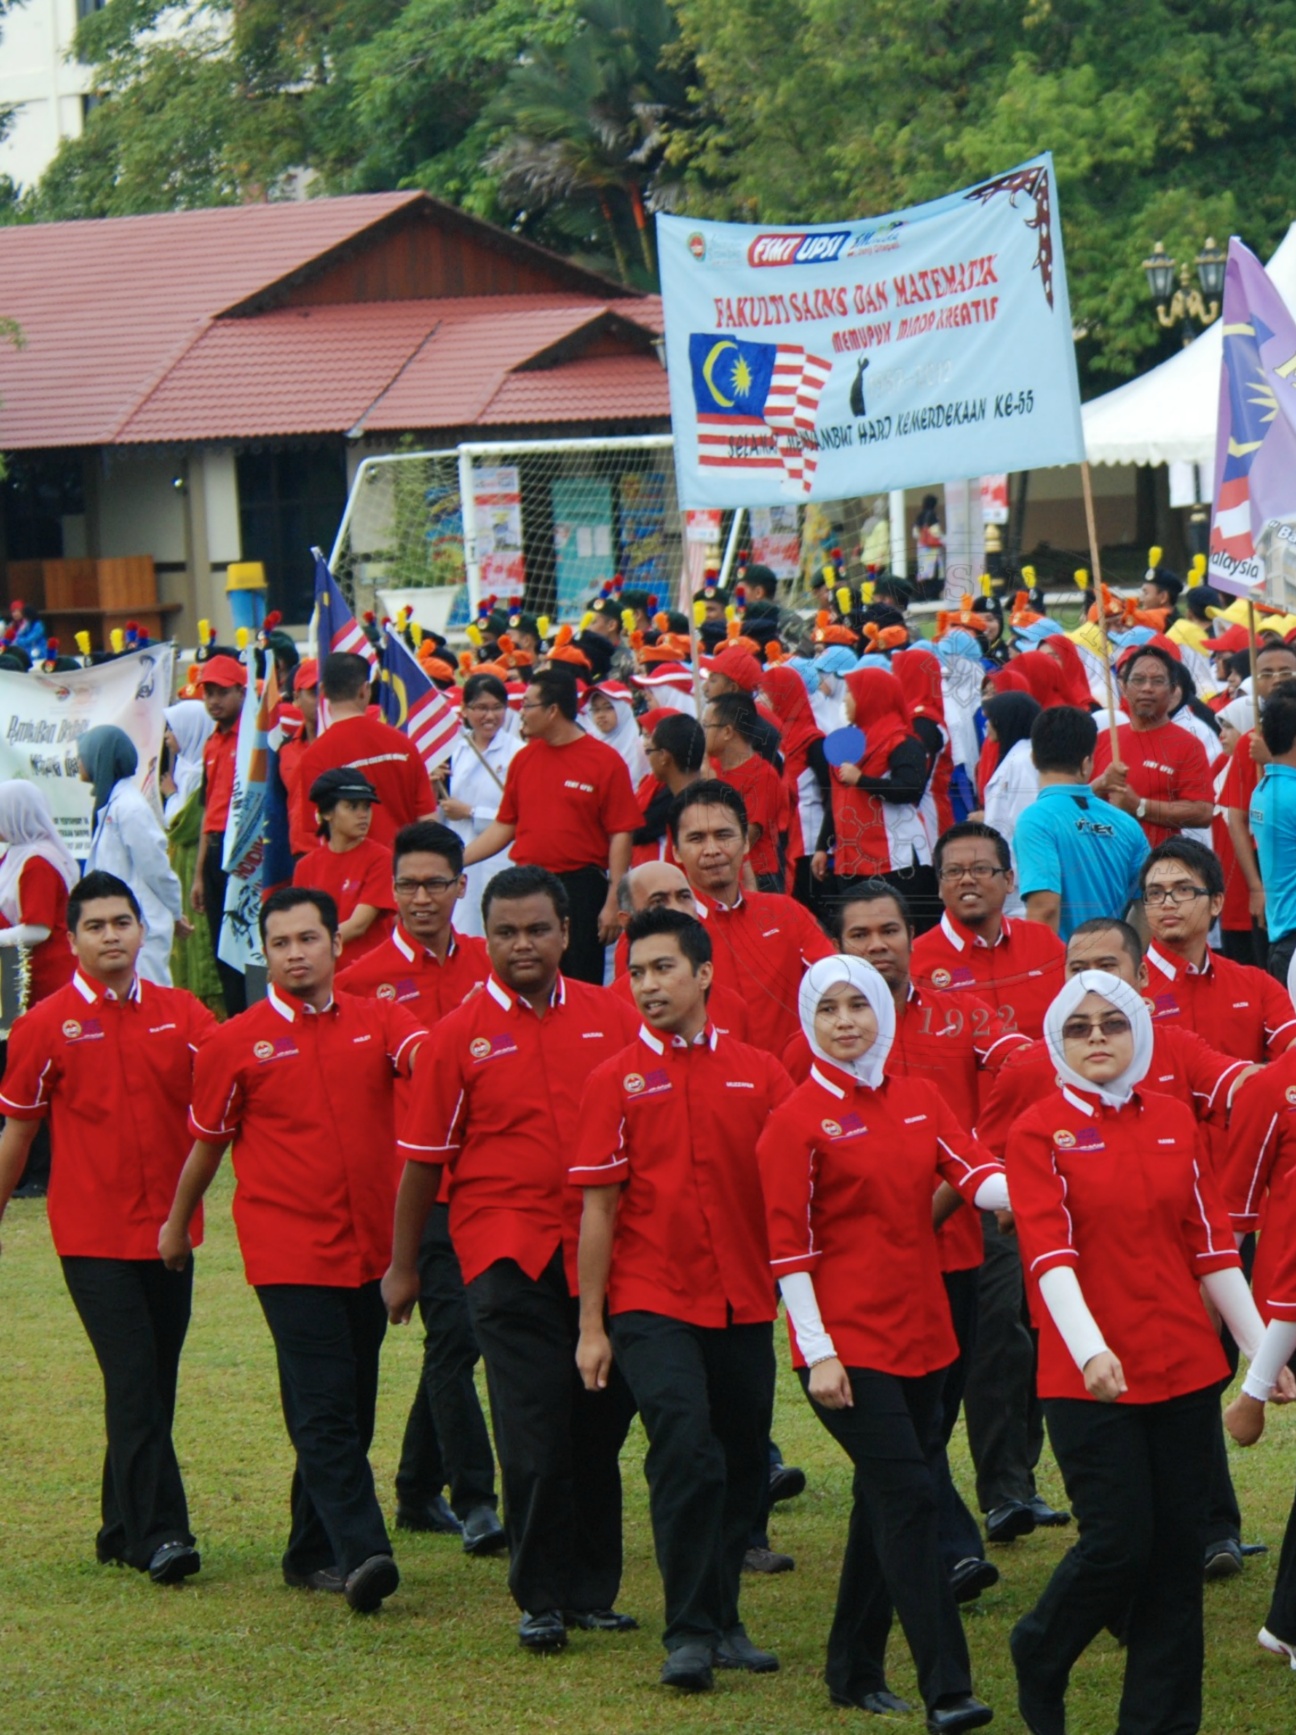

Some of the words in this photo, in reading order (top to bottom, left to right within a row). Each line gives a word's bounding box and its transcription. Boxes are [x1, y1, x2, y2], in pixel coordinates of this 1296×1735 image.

[753, 236, 801, 264] FSMT
[796, 234, 845, 261] UPSI
[713, 291, 791, 328] FAKULTI
[790, 286, 848, 322] SAINS
[853, 280, 888, 315] DAN
[893, 254, 998, 307] MATEMATIK
[832, 321, 892, 353] MEMUPUK
[936, 296, 999, 330] KREATIF
[895, 399, 986, 436] KEMERDEKAAN
[993, 390, 1035, 420] KE-55
